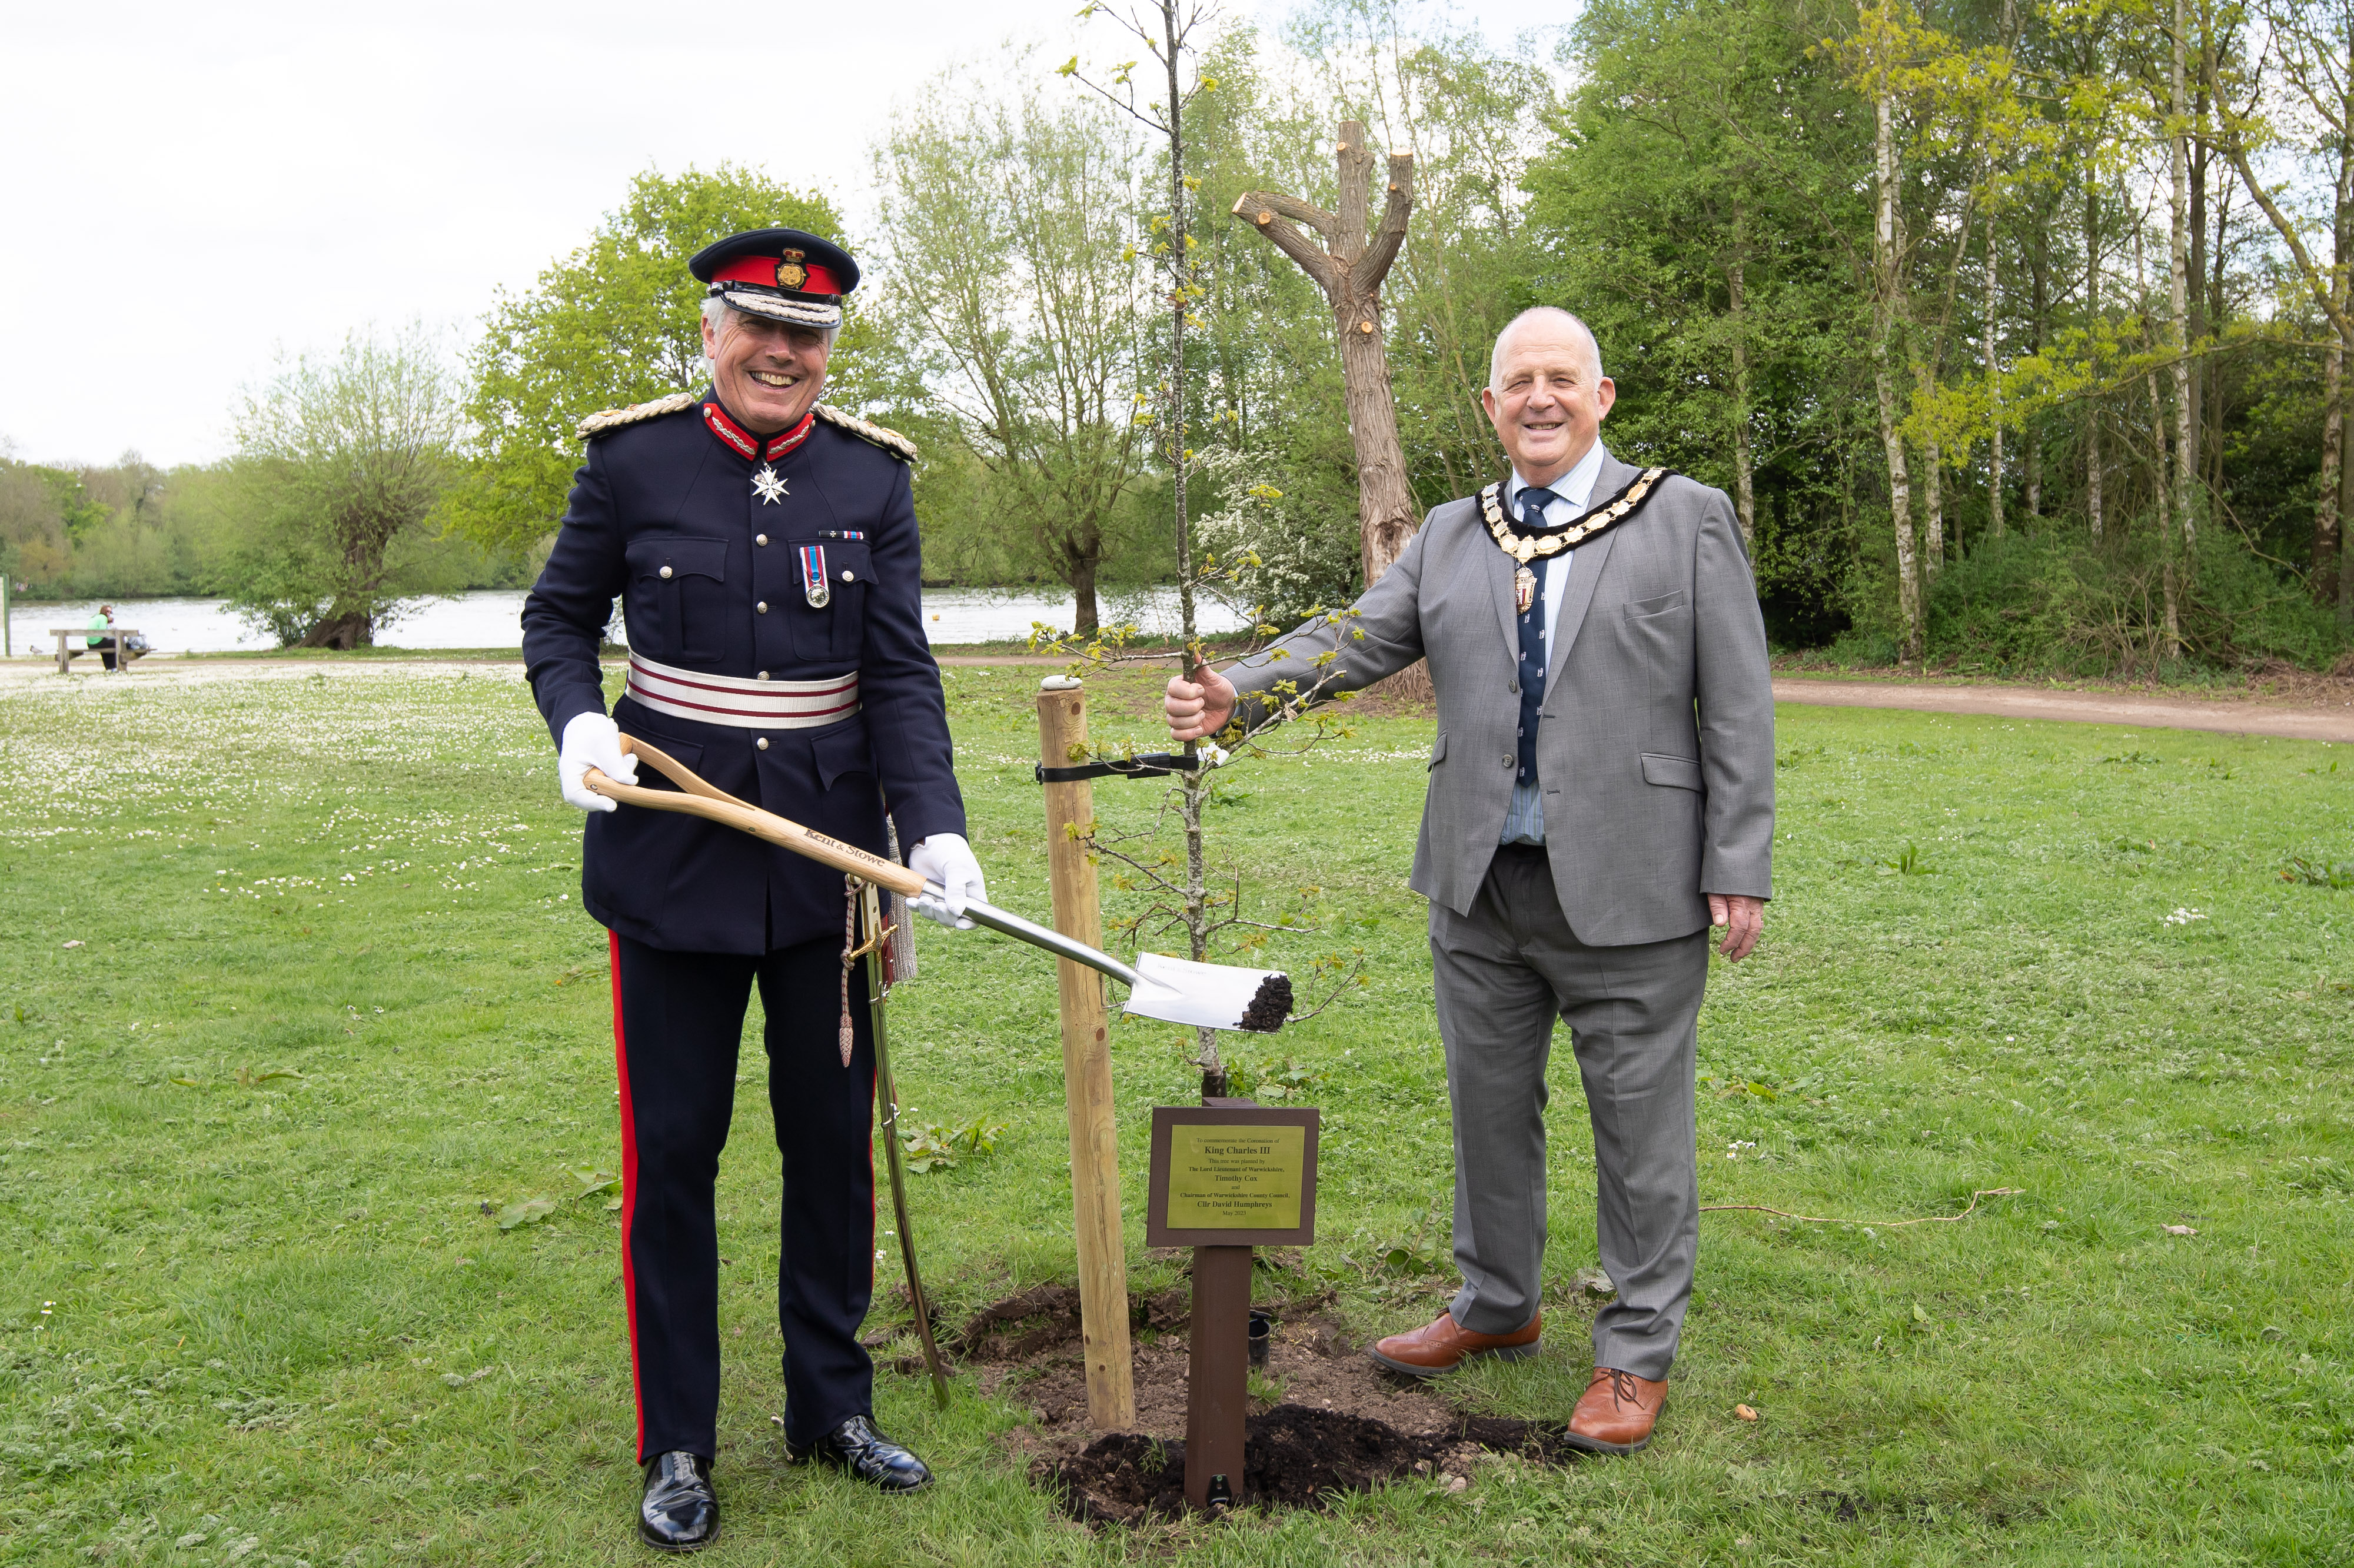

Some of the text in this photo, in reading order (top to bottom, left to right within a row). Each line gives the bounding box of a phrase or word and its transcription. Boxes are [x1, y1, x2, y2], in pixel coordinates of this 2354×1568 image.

[804, 829, 836, 847] Kent
[846, 846, 885, 867] Stowe
[1205, 1146, 1271, 1156] King Charles III
